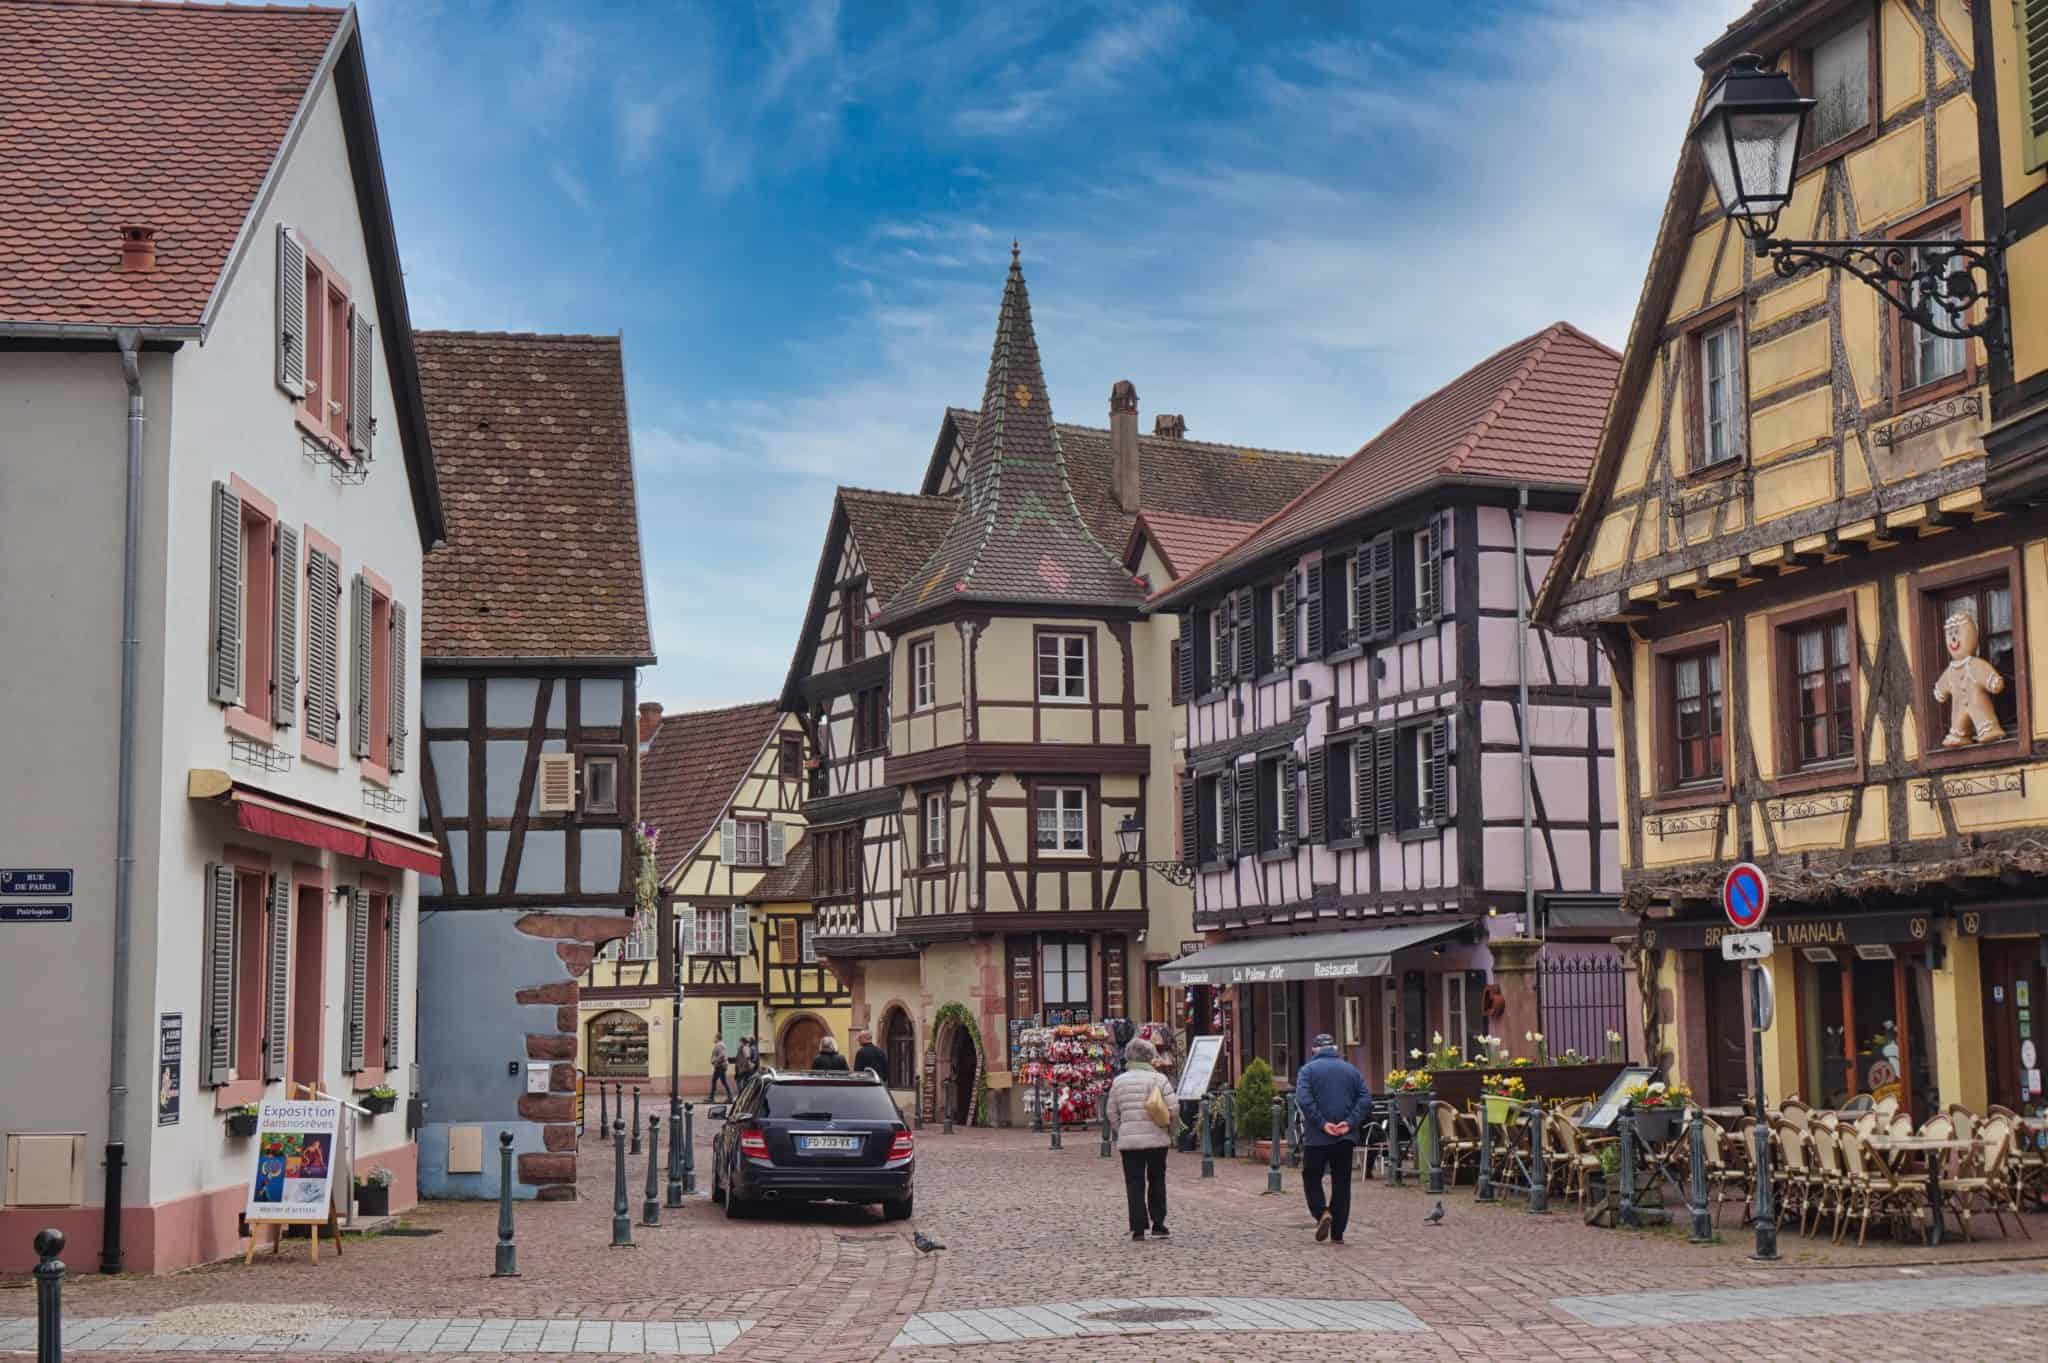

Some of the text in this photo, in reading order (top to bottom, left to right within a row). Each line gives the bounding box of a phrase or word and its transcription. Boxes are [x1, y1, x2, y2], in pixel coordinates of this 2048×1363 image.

[27, 873, 45, 881] RUE
[1787, 921, 1846, 944] MANALA
[1232, 968, 1242, 981] La
[1245, 967, 1266, 980] Palme
[1314, 960, 1359, 976] Restaurant
[264, 1105, 336, 1119] Exposition
